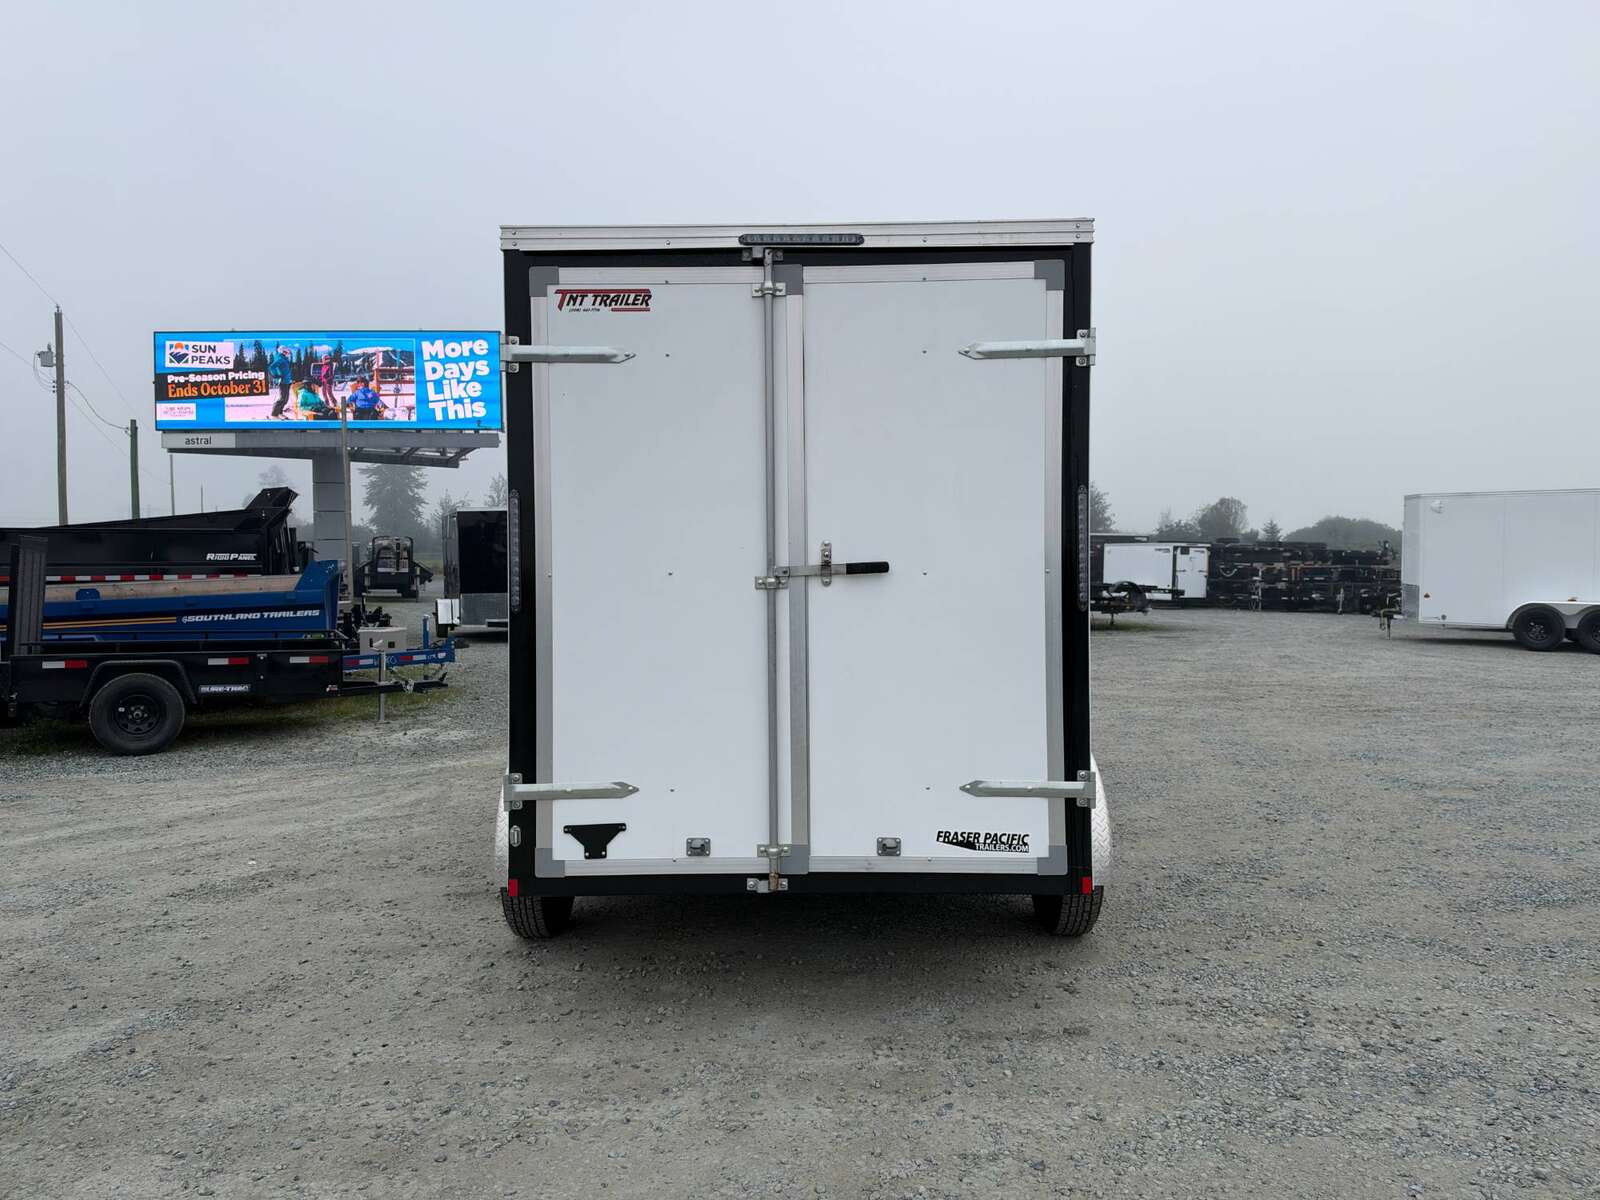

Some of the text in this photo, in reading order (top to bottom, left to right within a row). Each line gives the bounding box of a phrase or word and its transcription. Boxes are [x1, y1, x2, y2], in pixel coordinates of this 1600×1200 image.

[554, 289, 652, 311] TNT TRAILER
[191, 344, 216, 354] SUN
[421, 339, 489, 360] More
[191, 355, 231, 365] PEAKS
[167, 371, 265, 383] Pre-Season Pricing
[424, 360, 490, 381] Days
[168, 380, 266, 398] Ends October 31
[426, 378, 482, 401] Like
[428, 398, 487, 421] This
[185, 436, 212, 445] astral
[186, 610, 320, 623] SOUTHLAND TRAILERS
[936, 830, 1030, 846] FRASER PACIFIC
[975, 843, 1030, 853] TRAILERS.COM
